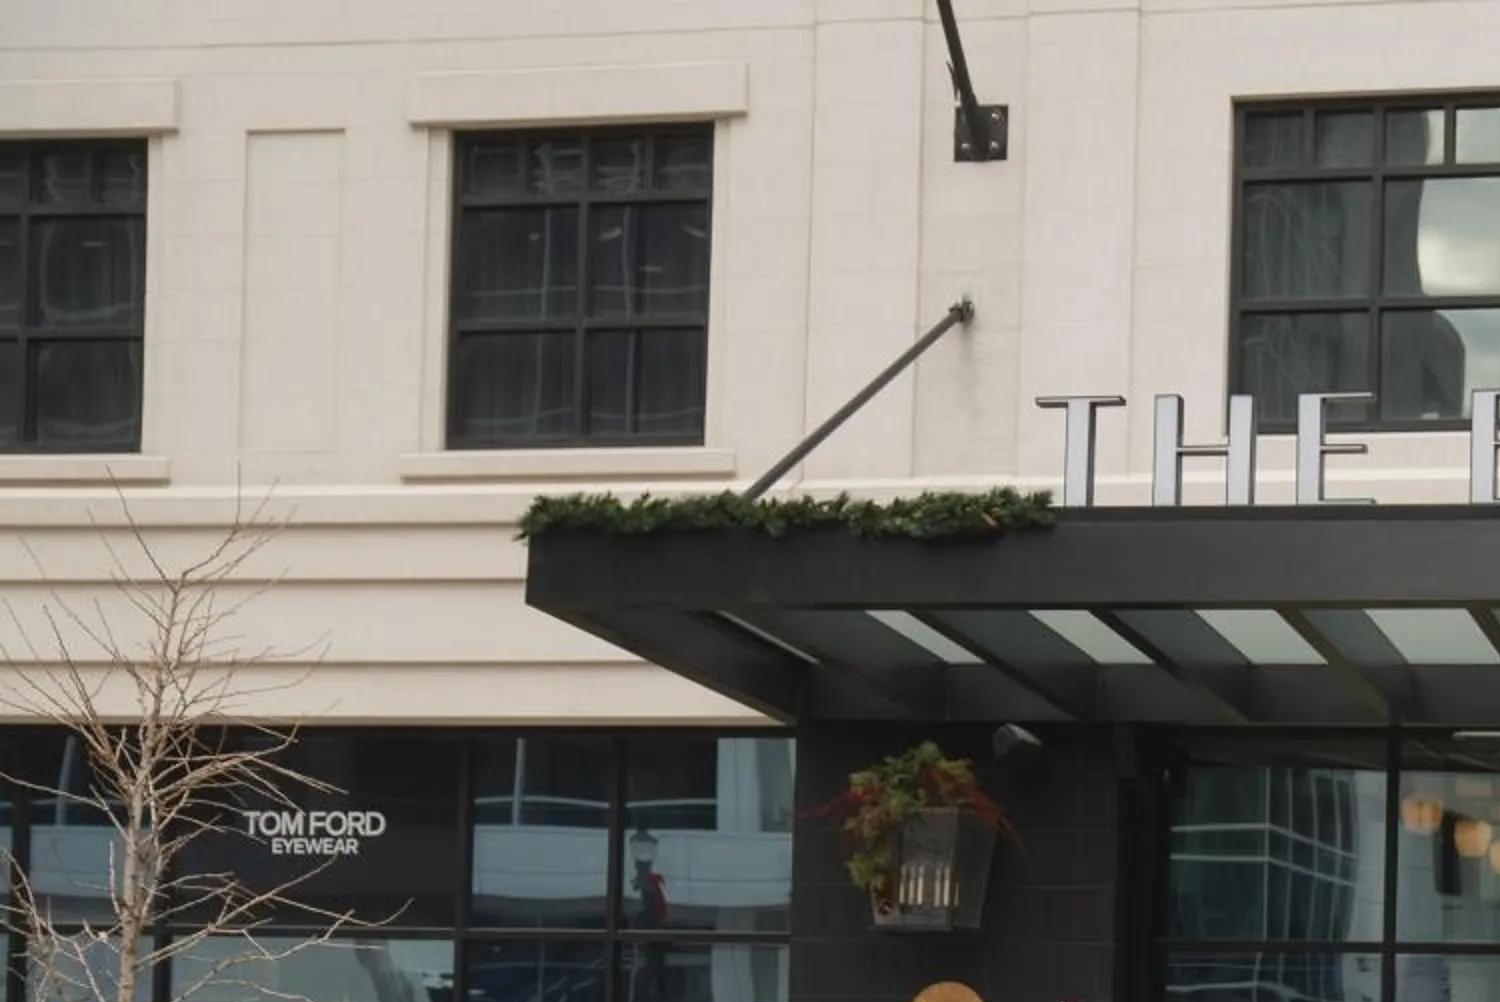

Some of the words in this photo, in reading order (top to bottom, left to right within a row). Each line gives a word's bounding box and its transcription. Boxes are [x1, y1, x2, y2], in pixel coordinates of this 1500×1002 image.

[1035, 391, 1377, 506] THE
[242, 811, 304, 836] TOM
[309, 811, 386, 836] FORD
[271, 838, 359, 855] EYEWEAR
